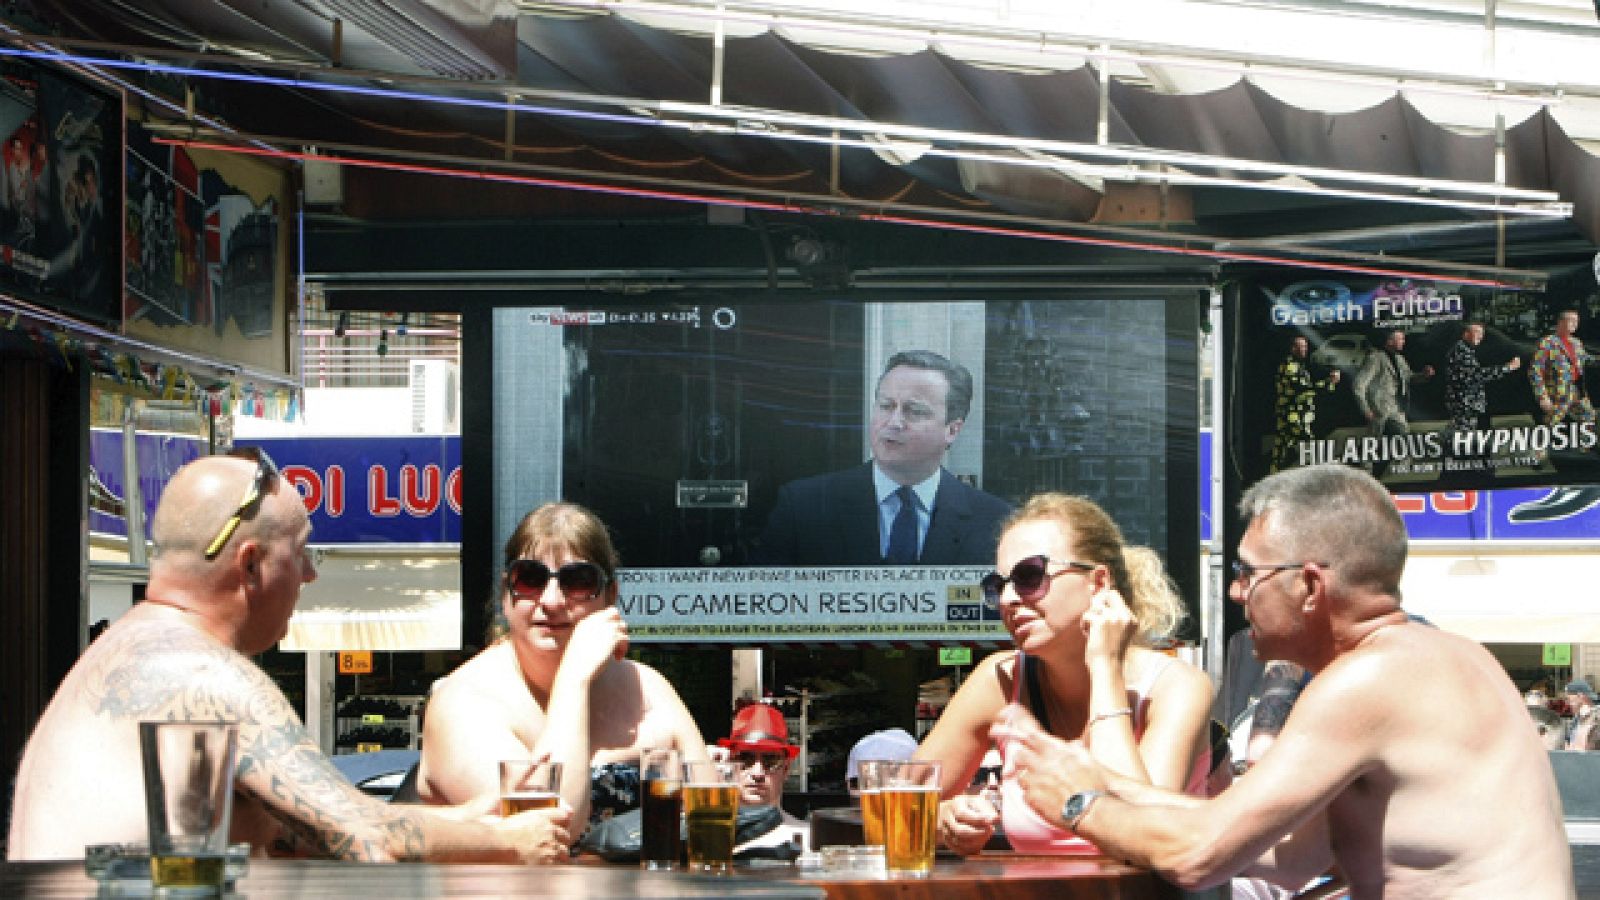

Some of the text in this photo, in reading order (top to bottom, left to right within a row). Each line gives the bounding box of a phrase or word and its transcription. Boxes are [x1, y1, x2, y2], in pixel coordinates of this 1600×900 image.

[1271, 295, 1462, 326] Gareth Fulton
[1299, 422, 1598, 466] HILARIOUS HYPNOSIS
[669, 570, 710, 582] WANT
[713, 570, 746, 582] NEW
[795, 569, 861, 582] MINISTER
[865, 569, 878, 581] IN
[882, 569, 926, 581] PLACE
[954, 586, 971, 599] IN
[618, 591, 937, 615] VID CAMERON RESIGNS
[950, 606, 978, 619] OUT
